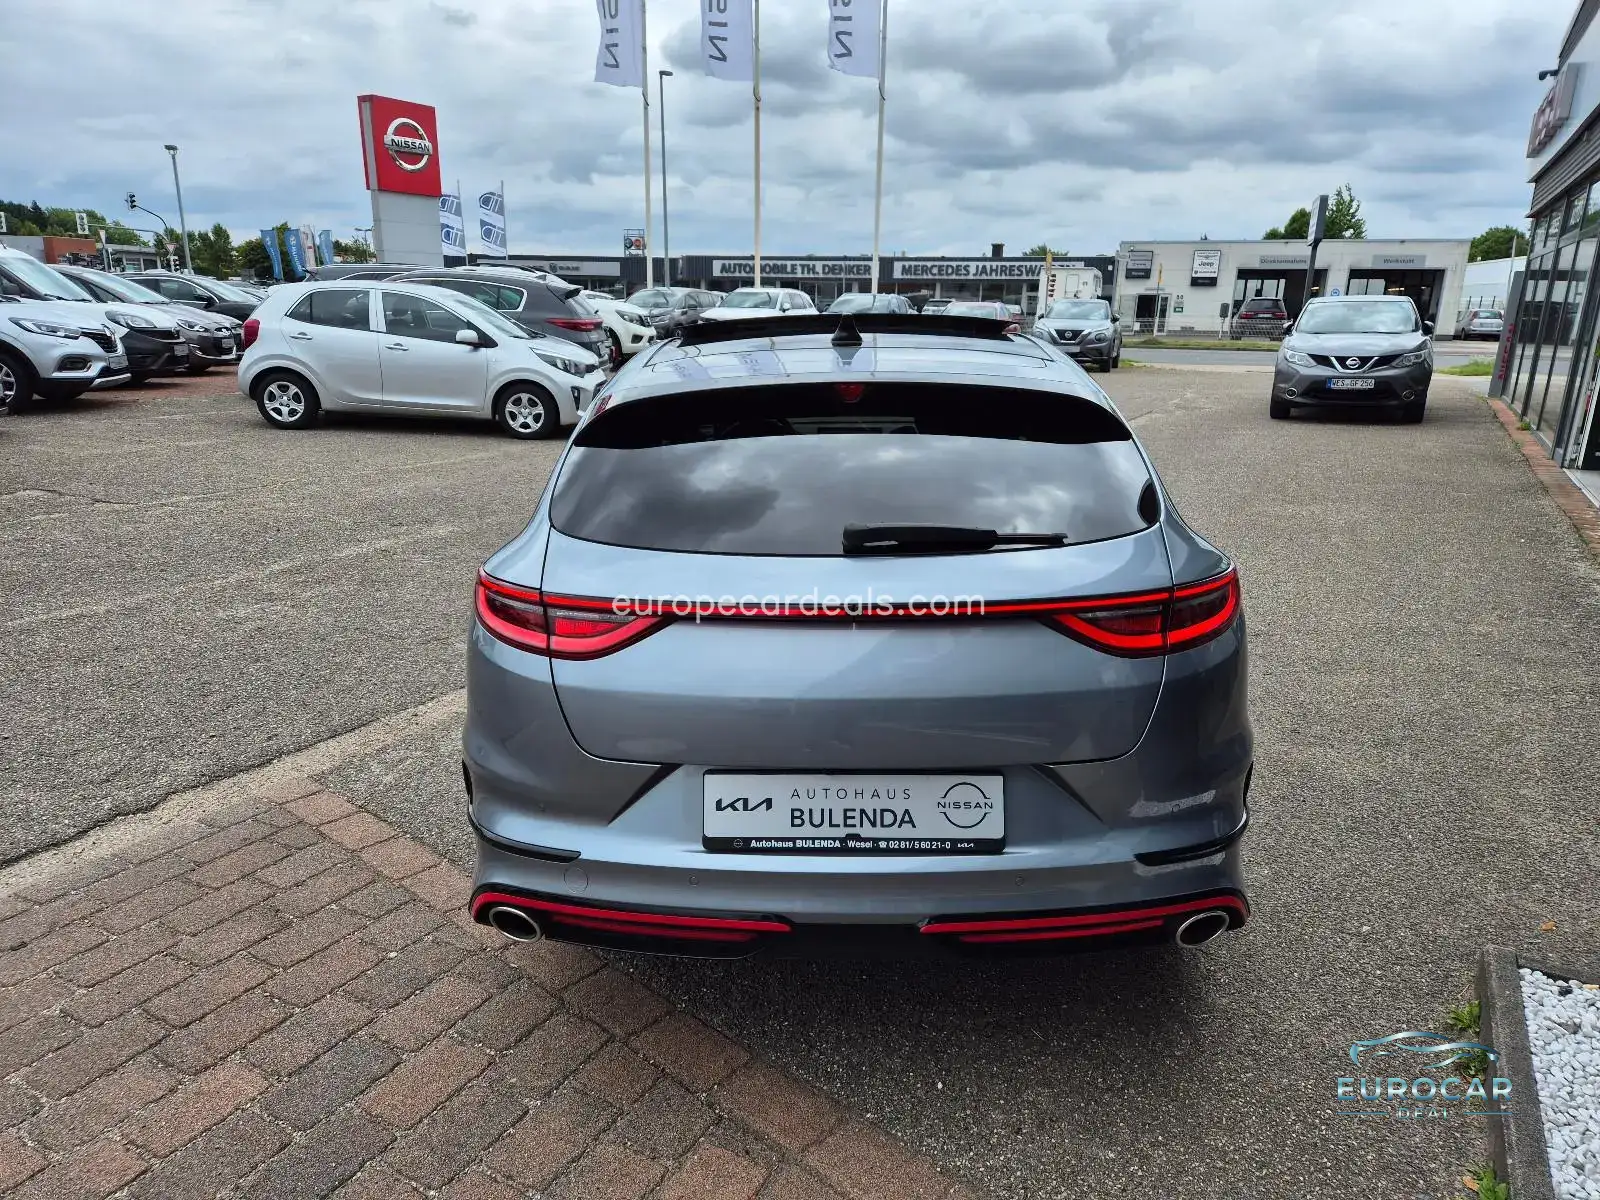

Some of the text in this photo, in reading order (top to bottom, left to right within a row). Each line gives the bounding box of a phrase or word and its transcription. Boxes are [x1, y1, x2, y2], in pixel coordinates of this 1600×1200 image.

[390, 137, 430, 152] NISSAN
[901, 263, 1076, 278] MERCEDES JAHRESW
[790, 788, 911, 800] AUTOHAUS
[937, 801, 994, 810] NISSAN
[790, 807, 917, 829] BULENDA
[750, 840, 794, 848] Autohaus
[795, 840, 841, 848] BULENDA
[847, 840, 873, 849] Wesel
